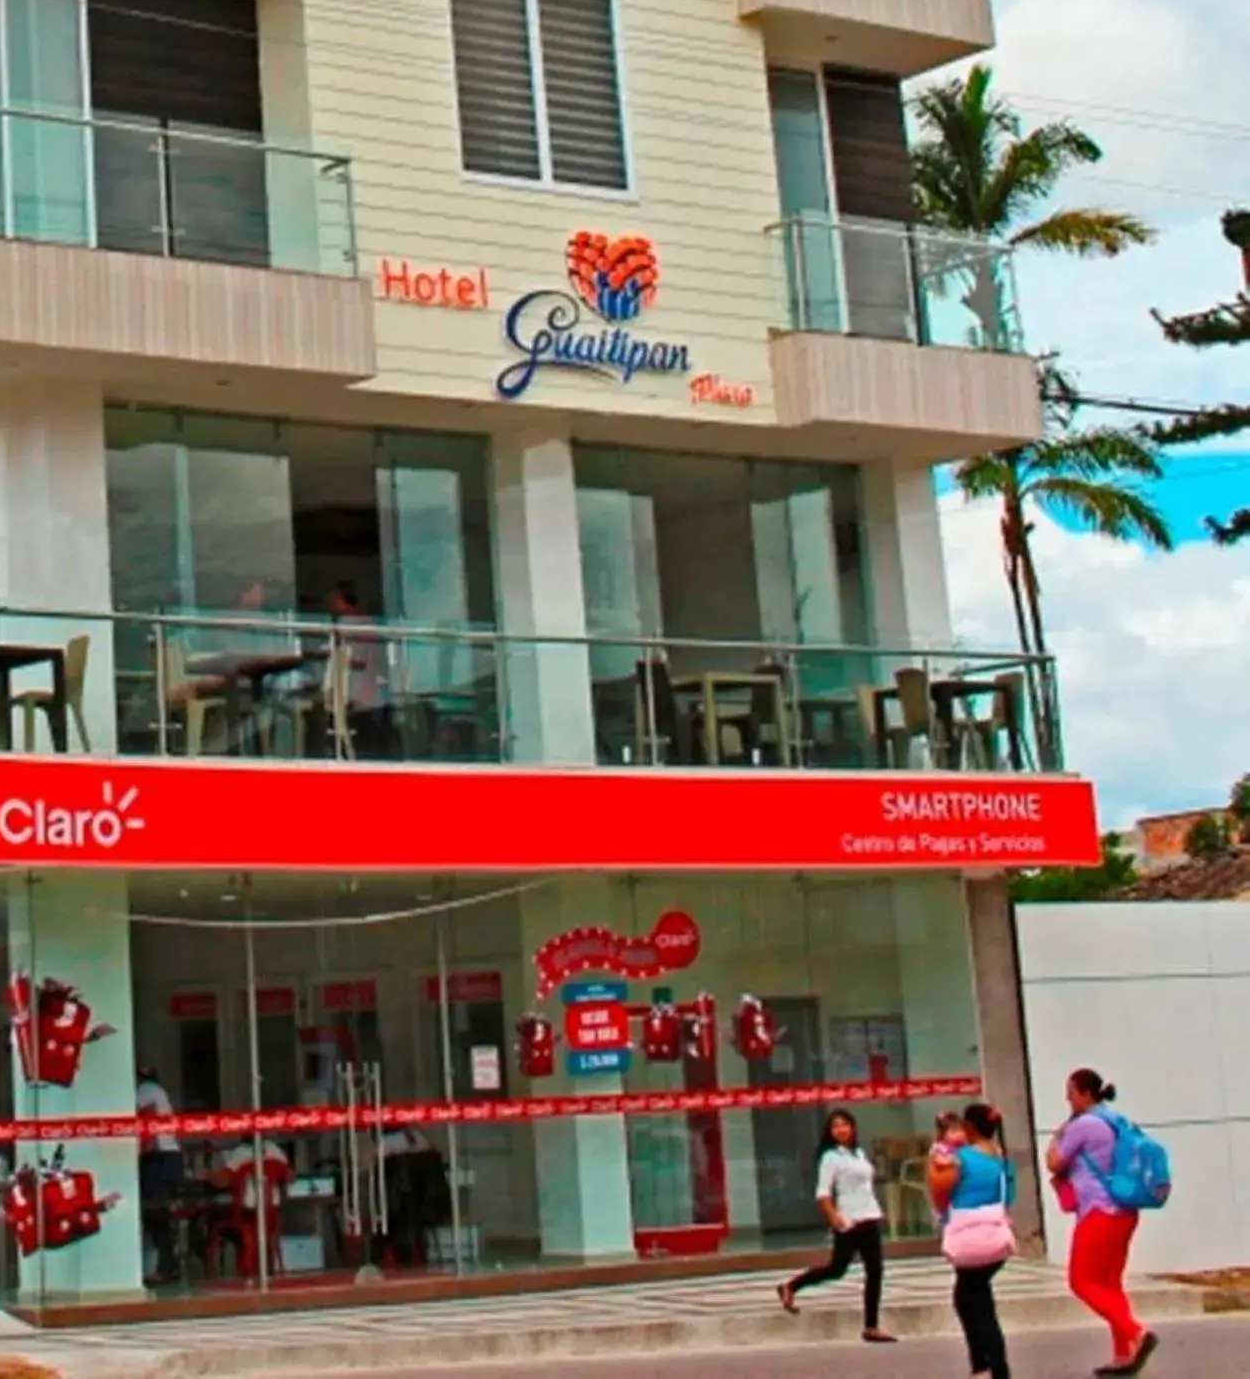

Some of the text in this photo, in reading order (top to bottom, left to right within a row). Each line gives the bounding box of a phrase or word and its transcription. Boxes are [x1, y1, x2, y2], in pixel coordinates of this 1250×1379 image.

[379, 257, 490, 310] Hotel
[495, 289, 692, 400] Guaitipan
[880, 791, 1043, 821] SMARTPHONE
